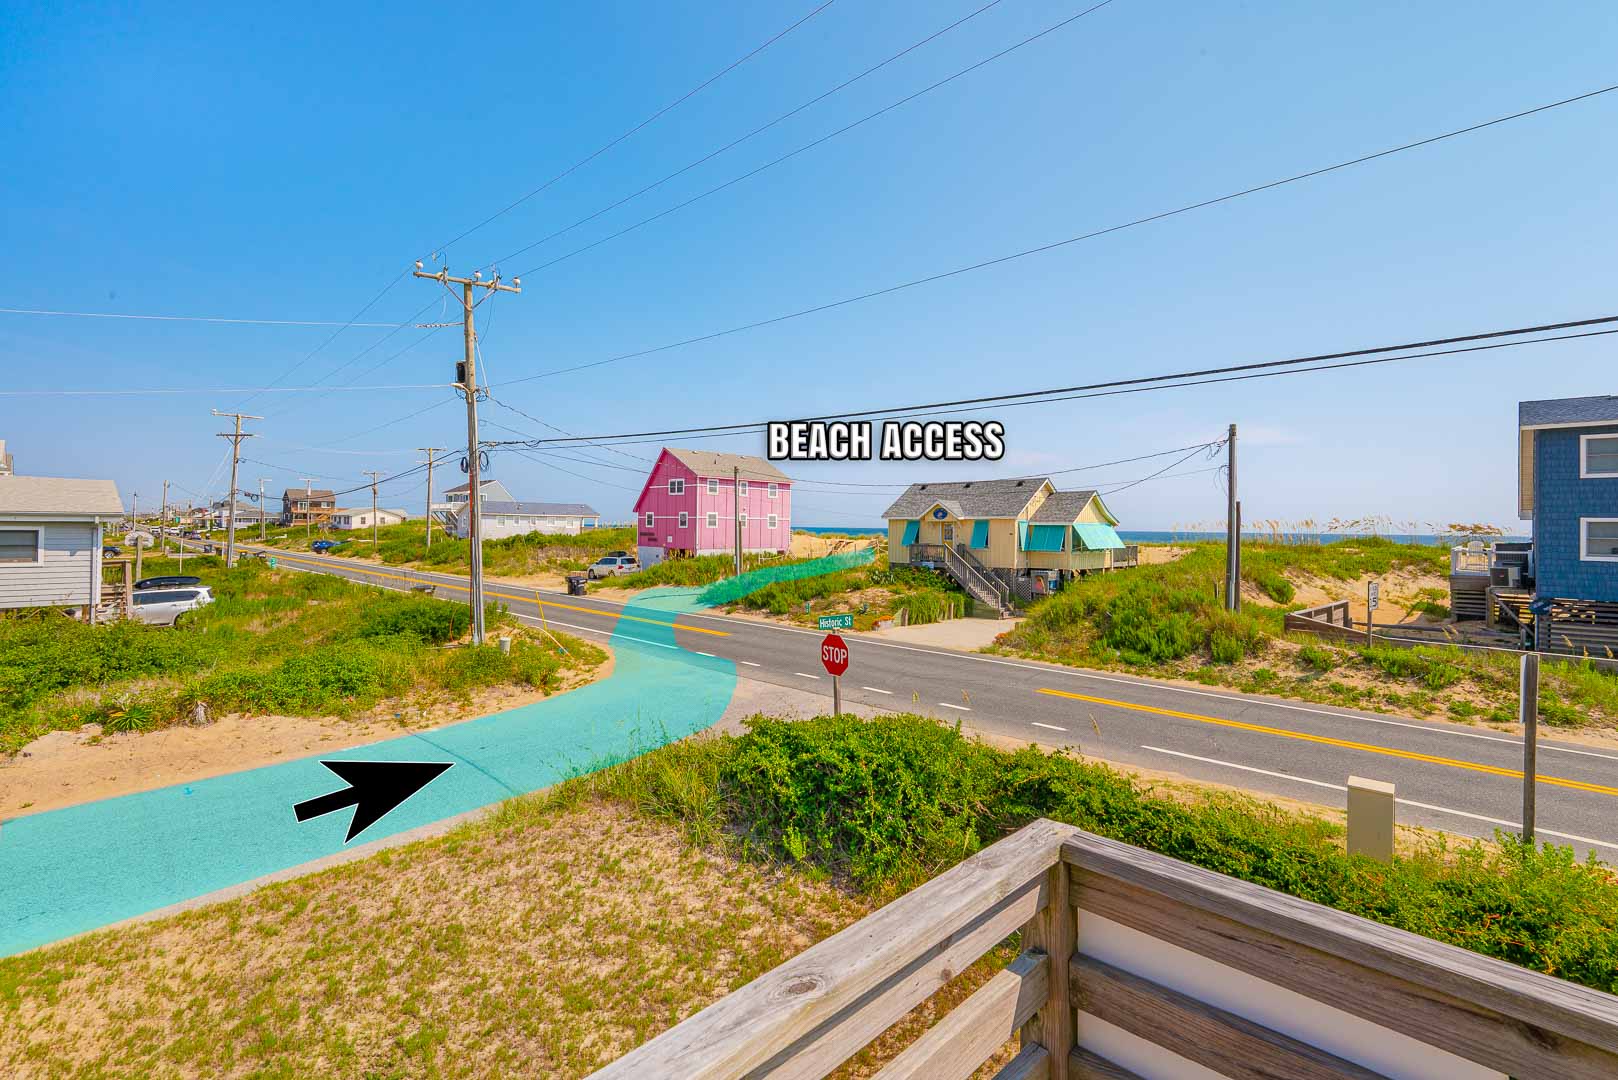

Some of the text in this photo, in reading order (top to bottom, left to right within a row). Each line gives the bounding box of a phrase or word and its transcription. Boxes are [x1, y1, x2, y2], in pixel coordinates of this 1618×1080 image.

[820, 616, 851, 629] Historic St
[823, 645, 847, 664] STOP
